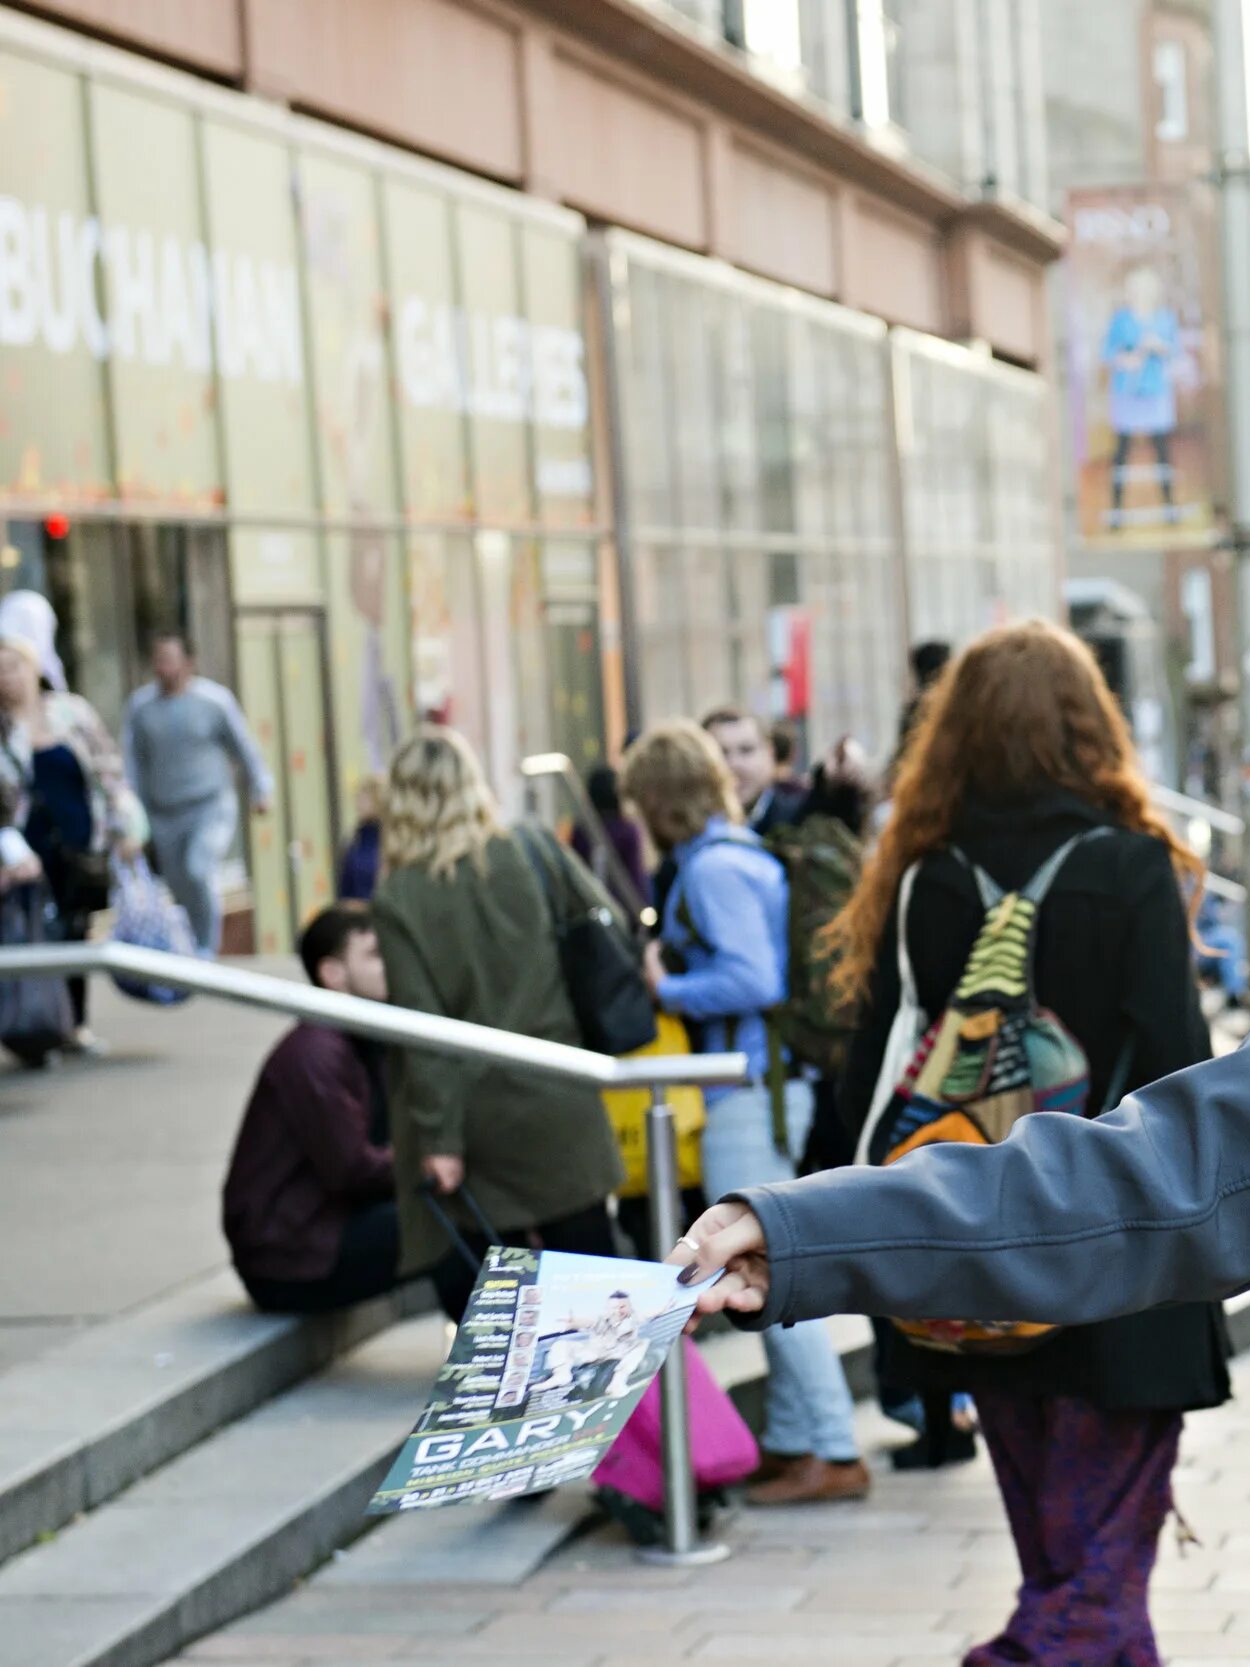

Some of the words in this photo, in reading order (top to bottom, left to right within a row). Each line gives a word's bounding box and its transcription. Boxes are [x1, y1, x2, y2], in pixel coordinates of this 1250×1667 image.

[0, 195, 304, 384] BUCHANAN
[410, 1461, 457, 1478] TANK
[459, 1434, 571, 1469] COMMANDER
[414, 1400, 619, 1465] GARY:
